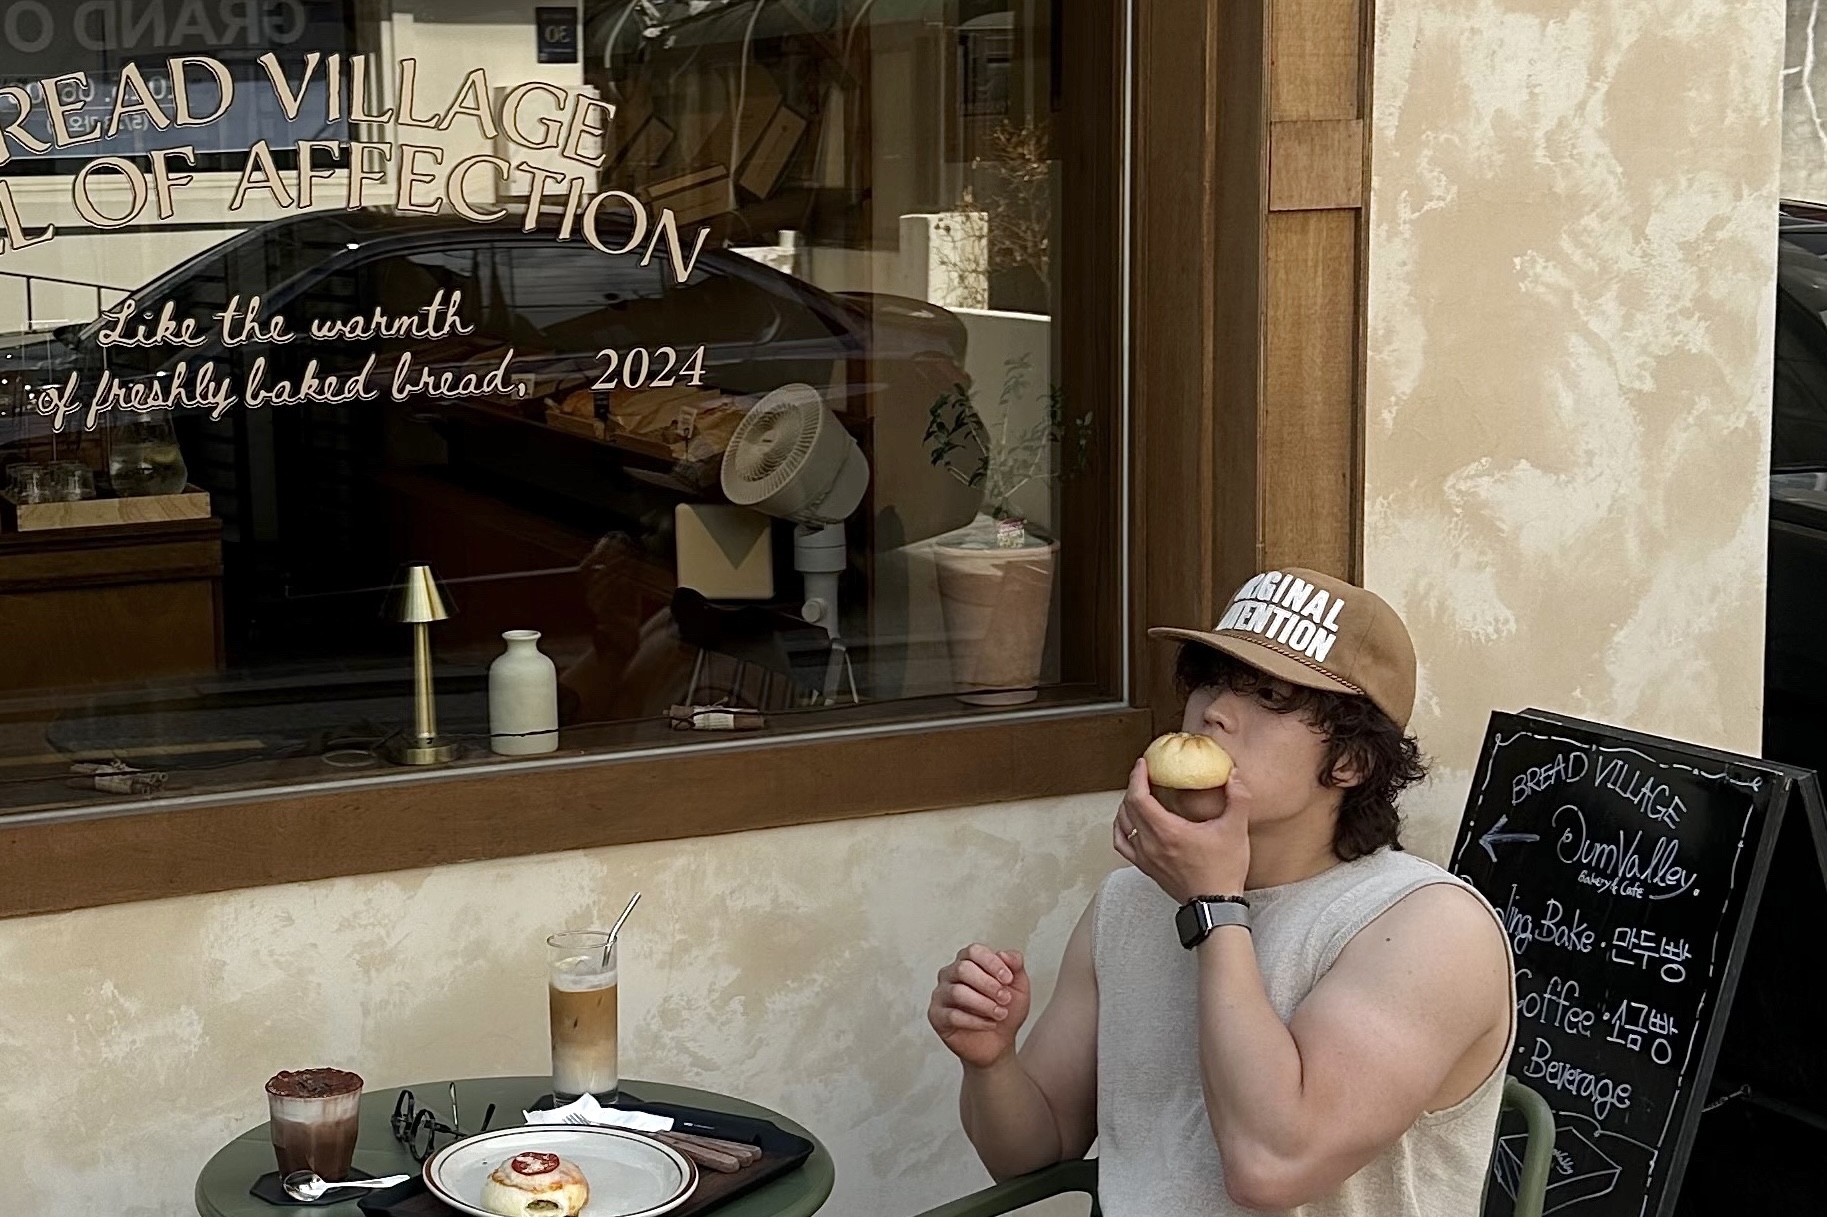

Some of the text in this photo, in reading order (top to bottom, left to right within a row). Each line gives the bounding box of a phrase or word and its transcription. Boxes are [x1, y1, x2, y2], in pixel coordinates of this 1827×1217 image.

[257, 52, 617, 168] VILLAGE
[72, 145, 196, 230] OF
[229, 139, 712, 284] AFFECTION
[97, 288, 476, 348] Like the warmth
[37, 348, 527, 433] of freshly baked bread,
[589, 344, 707, 392] 2024
[1512, 752, 1688, 830] BREAD VILLAGE
[1534, 898, 1596, 953] Bake
[1611, 927, 1692, 983] 만두빵
[1606, 999, 1679, 1065] 소금빵
[1523, 1037, 1632, 1120] Beverage
